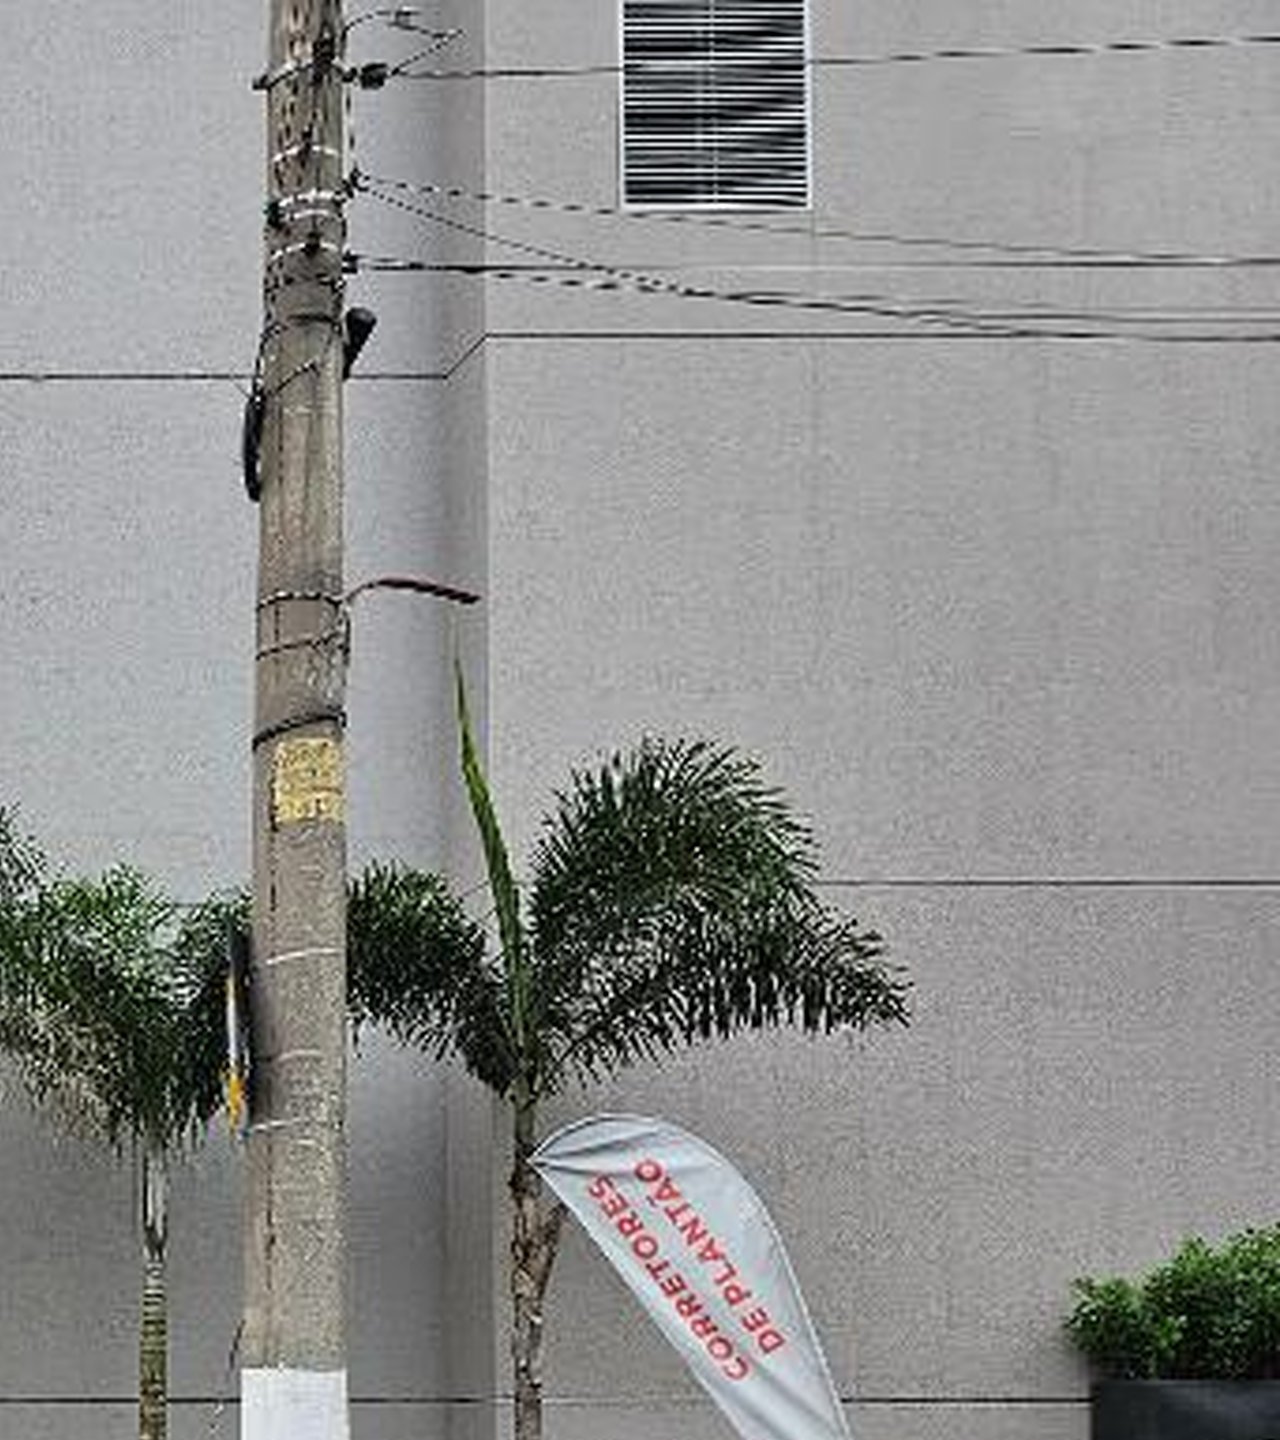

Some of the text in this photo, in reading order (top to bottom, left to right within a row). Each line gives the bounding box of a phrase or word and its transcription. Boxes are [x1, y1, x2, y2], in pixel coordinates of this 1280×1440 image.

[587, 1175, 750, 1380] CORRETORES
[634, 1159, 786, 1354] DE PLANTÃO
